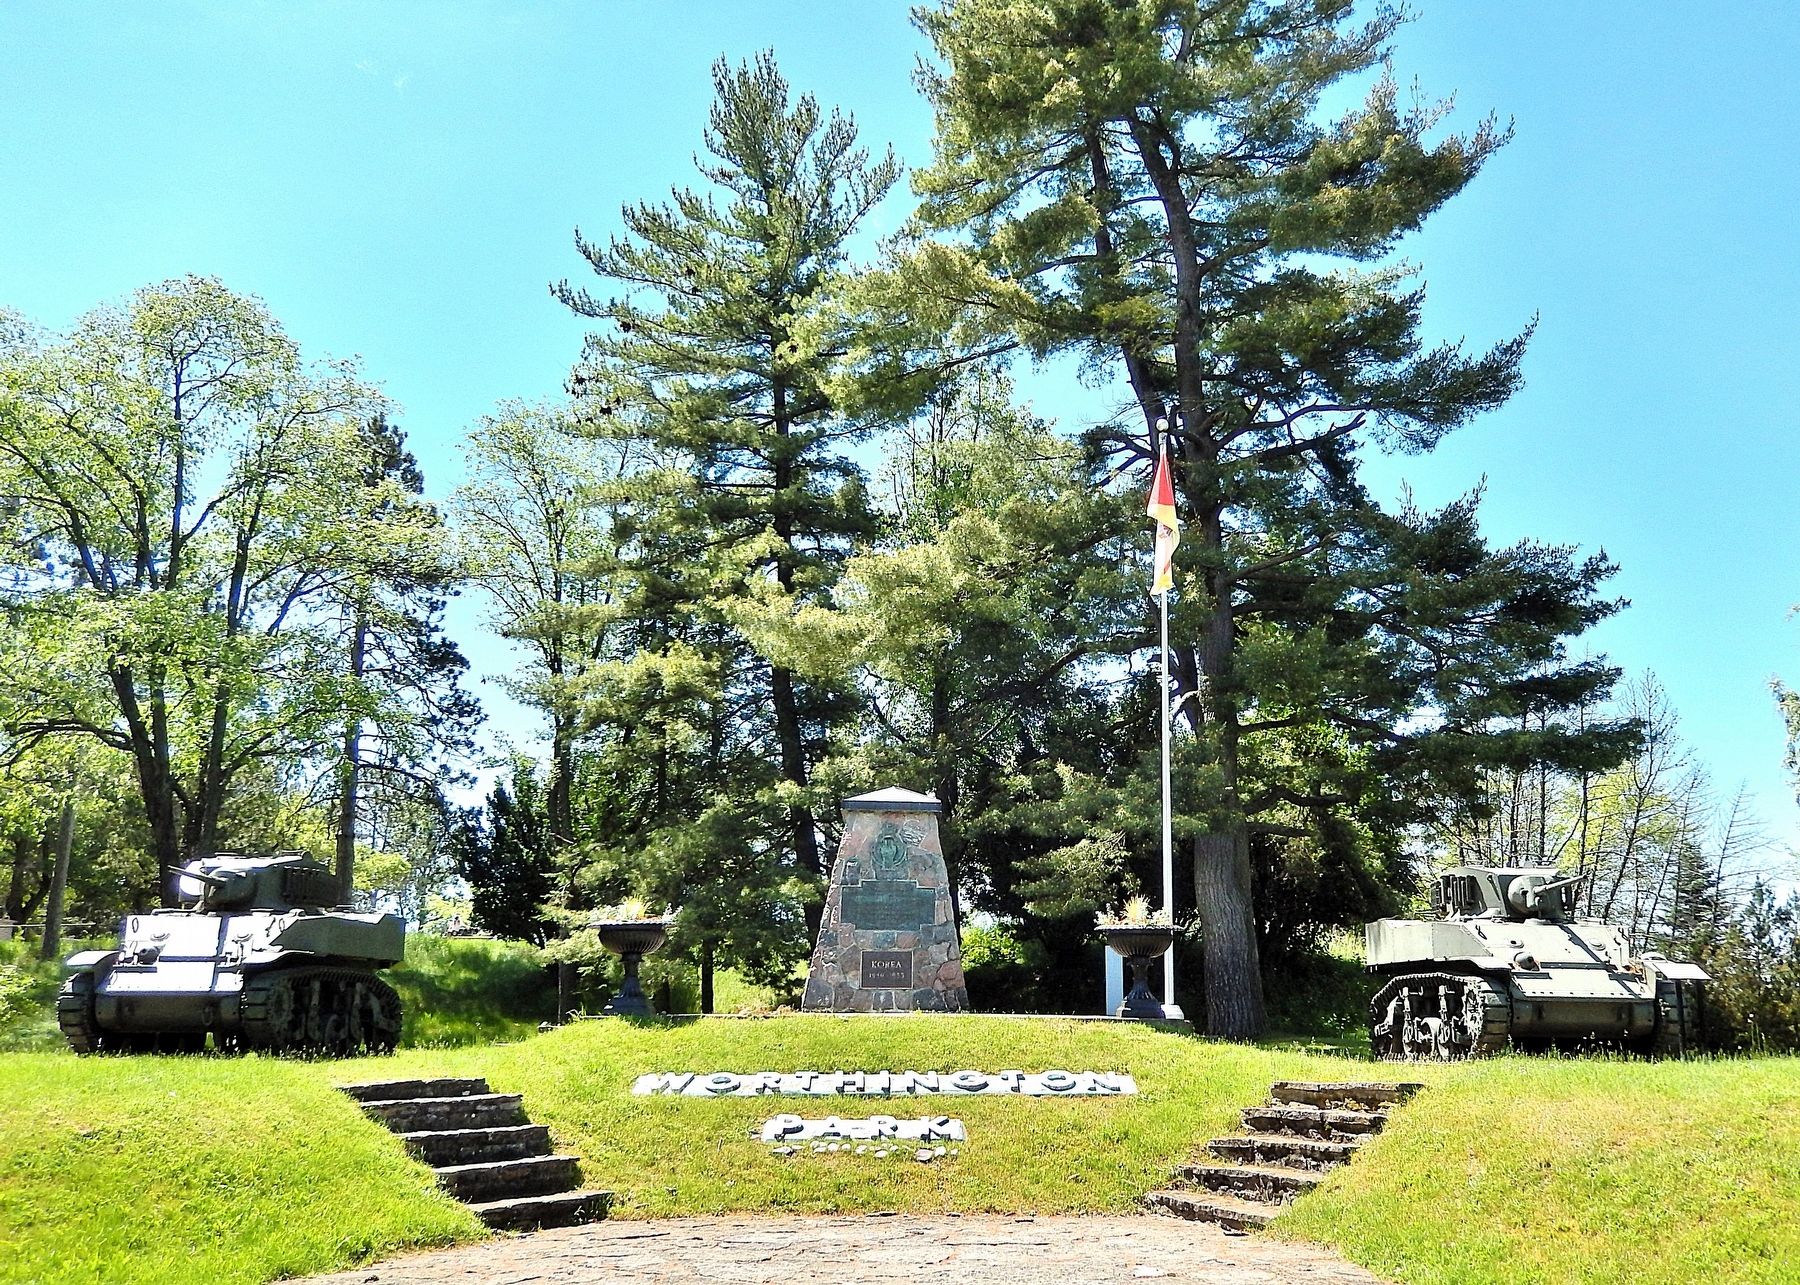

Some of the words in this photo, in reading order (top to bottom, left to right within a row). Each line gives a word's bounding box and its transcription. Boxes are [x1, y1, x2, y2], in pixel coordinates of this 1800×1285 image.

[871, 960, 902, 969] KOREA
[637, 1071, 1123, 1095] WORTHINGTON
[765, 1113, 954, 1142] PARK
